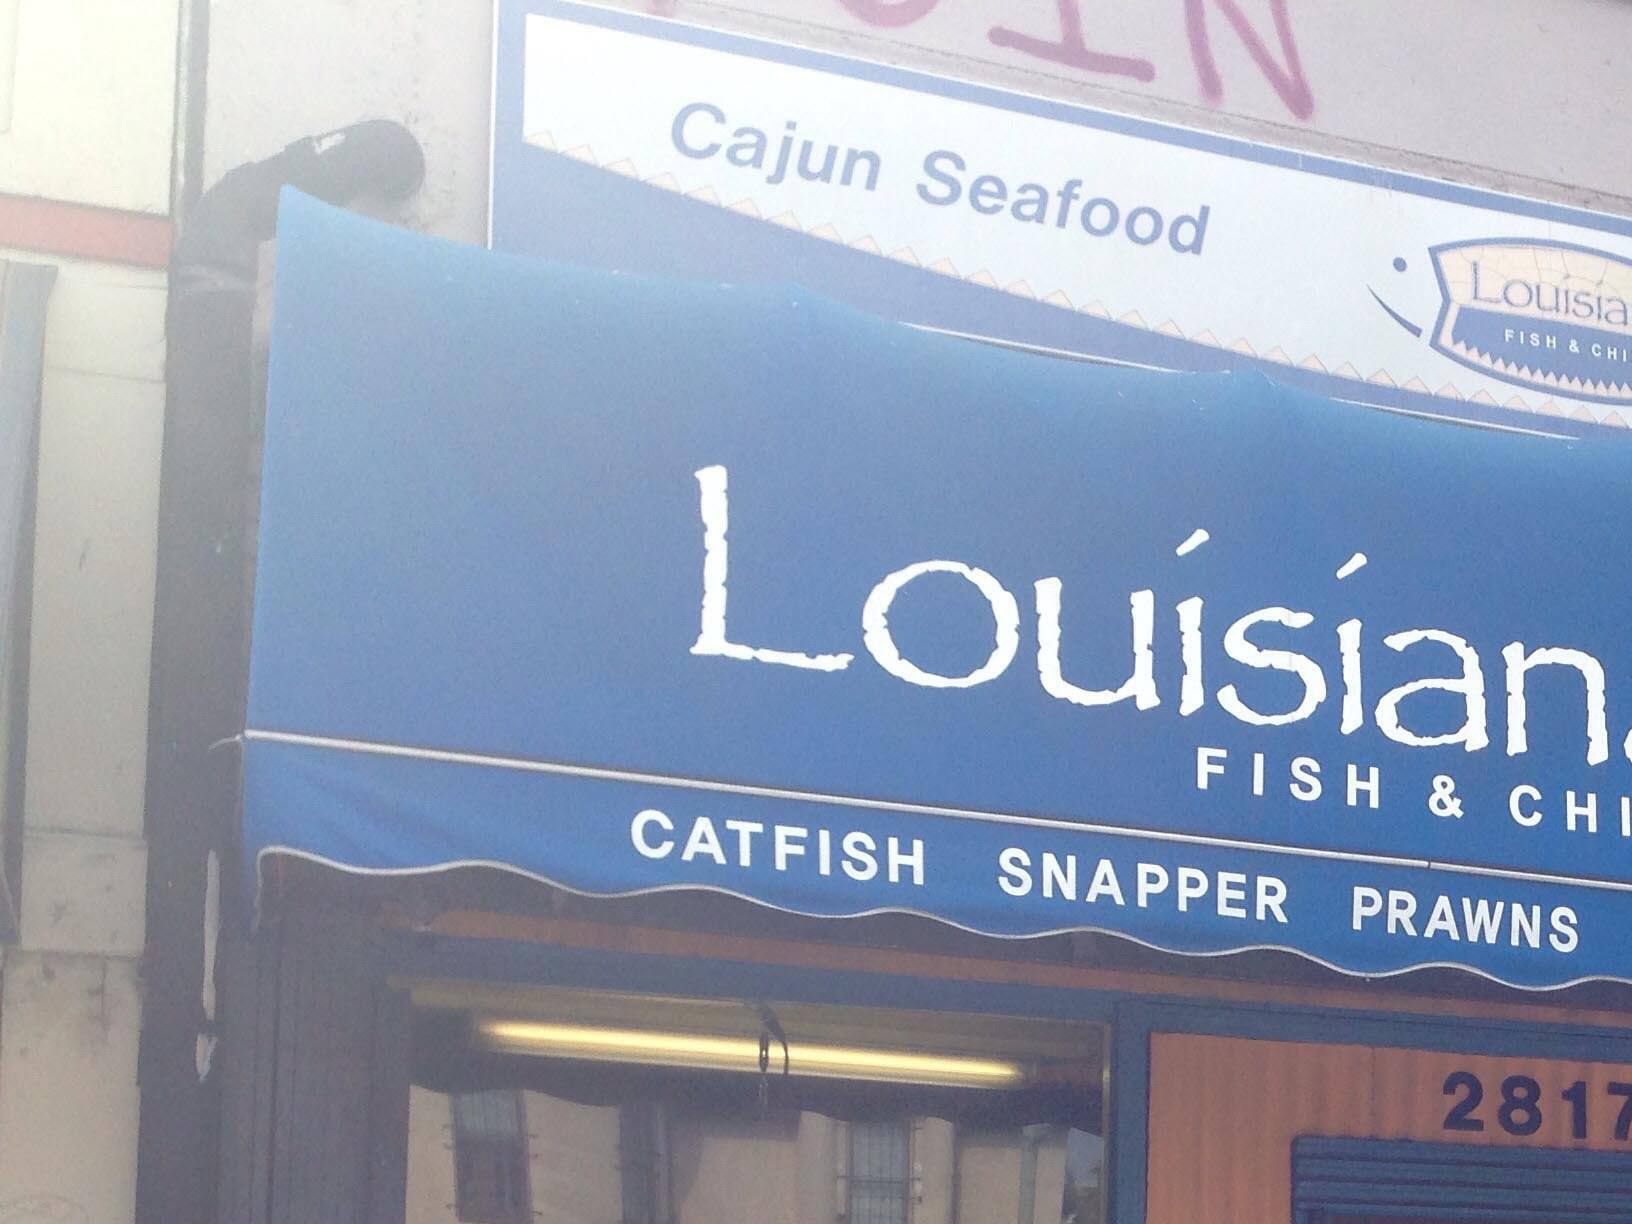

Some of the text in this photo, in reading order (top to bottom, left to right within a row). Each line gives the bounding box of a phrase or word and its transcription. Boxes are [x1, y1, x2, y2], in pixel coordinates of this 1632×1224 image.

[670, 101, 1211, 255] Cajun Seafood
[1504, 326, 1560, 352] FISH
[1569, 337, 1581, 354] &
[1197, 746, 1379, 809] FISH
[1428, 774, 1464, 819] &
[630, 808, 927, 887] CATFISH
[998, 846, 1289, 925] SNAPPER
[1352, 886, 1581, 954] PRAWNS
